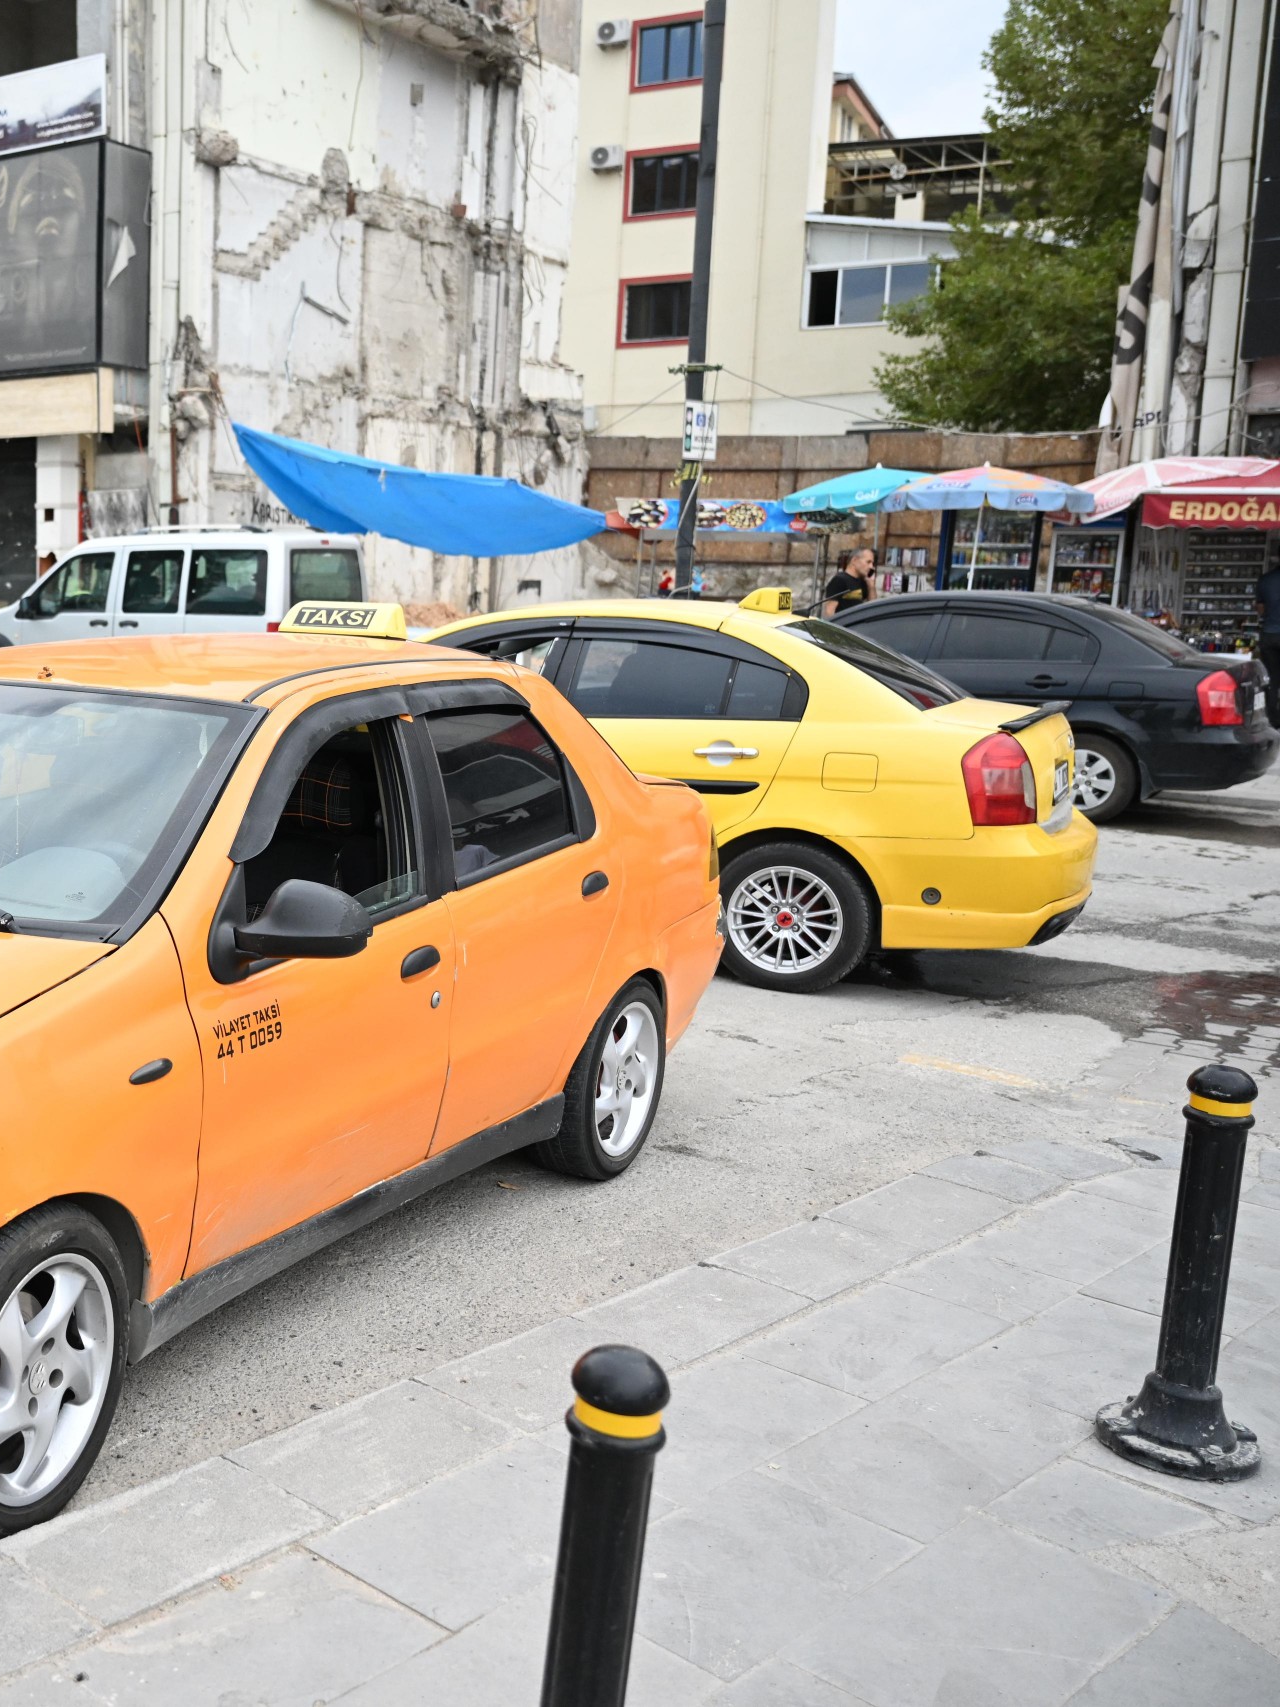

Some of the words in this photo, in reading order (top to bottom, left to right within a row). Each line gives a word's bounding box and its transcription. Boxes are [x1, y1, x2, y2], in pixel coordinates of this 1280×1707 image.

[1169, 496, 1280, 522] ERDOĞA
[213, 1019, 251, 1040] VİLAYET
[253, 998, 281, 1025] TAKSİ
[217, 1040, 234, 1060] 44
[238, 1035, 245, 1054] T
[249, 1021, 282, 1050] 0059
